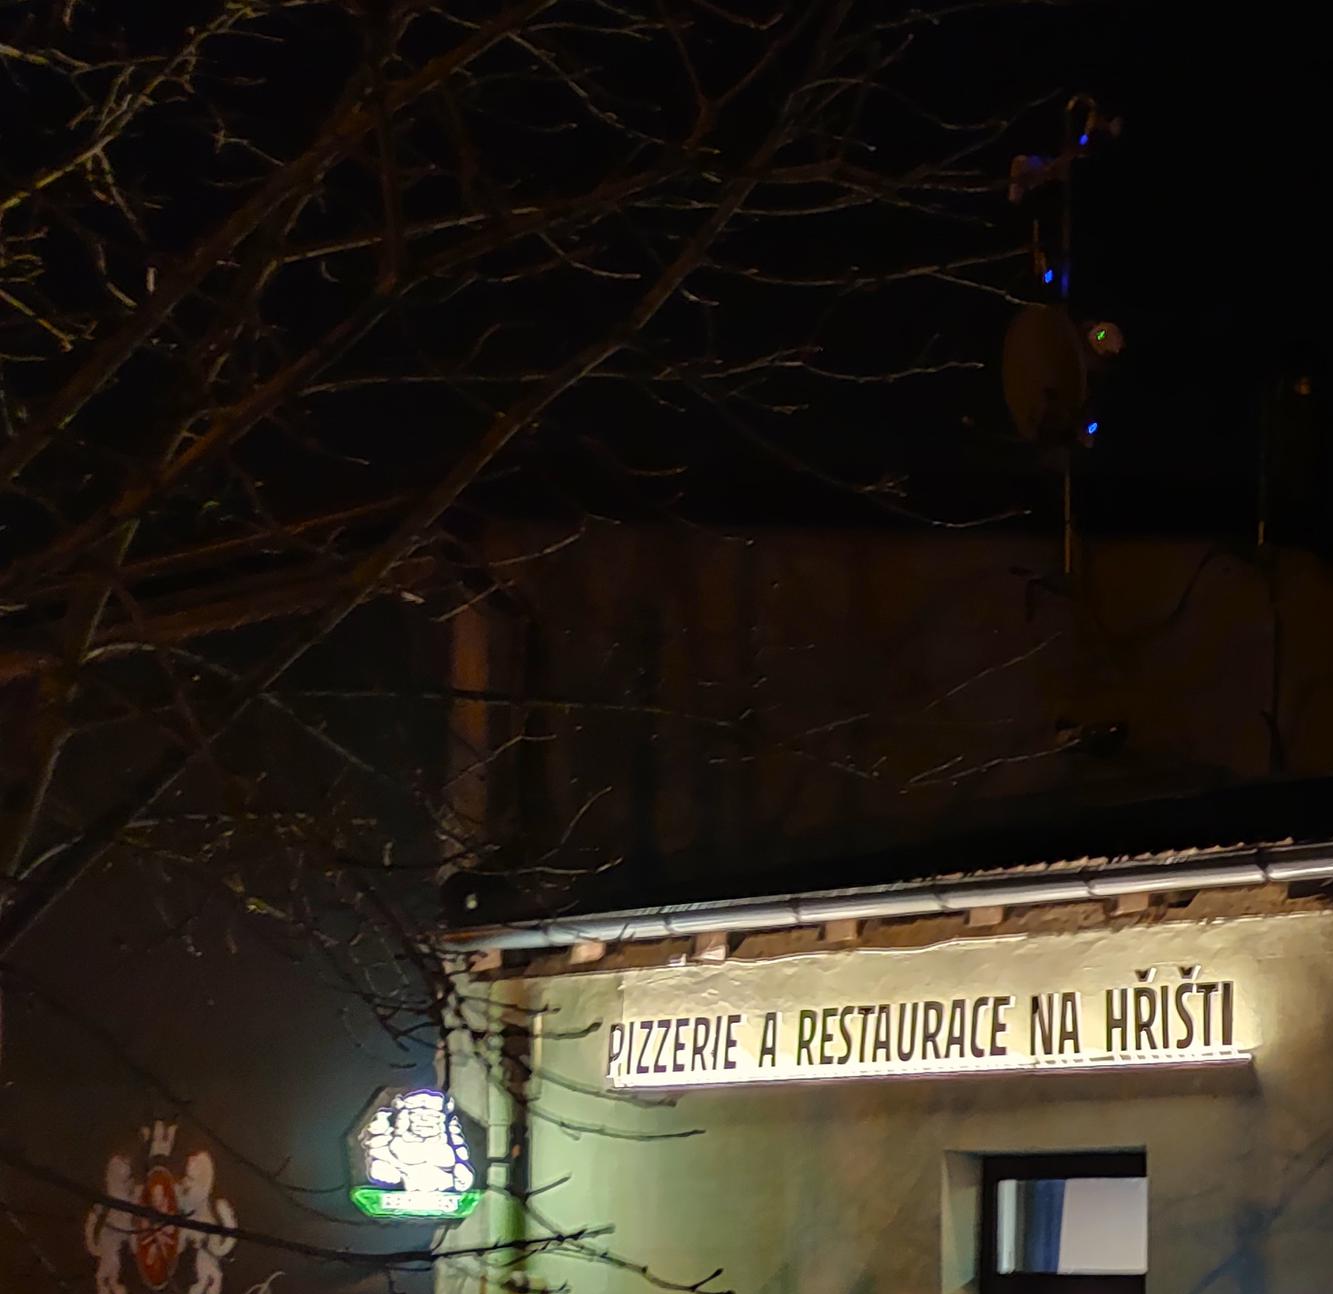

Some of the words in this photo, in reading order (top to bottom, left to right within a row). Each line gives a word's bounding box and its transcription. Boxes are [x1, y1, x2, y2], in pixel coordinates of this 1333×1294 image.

[607, 1014, 743, 1076] PIZZERIE
[758, 1012, 776, 1068] A
[797, 995, 1012, 1067] RESTAURACE
[1030, 991, 1081, 1056] NA
[1105, 966, 1234, 1052] HŘIŠTI
